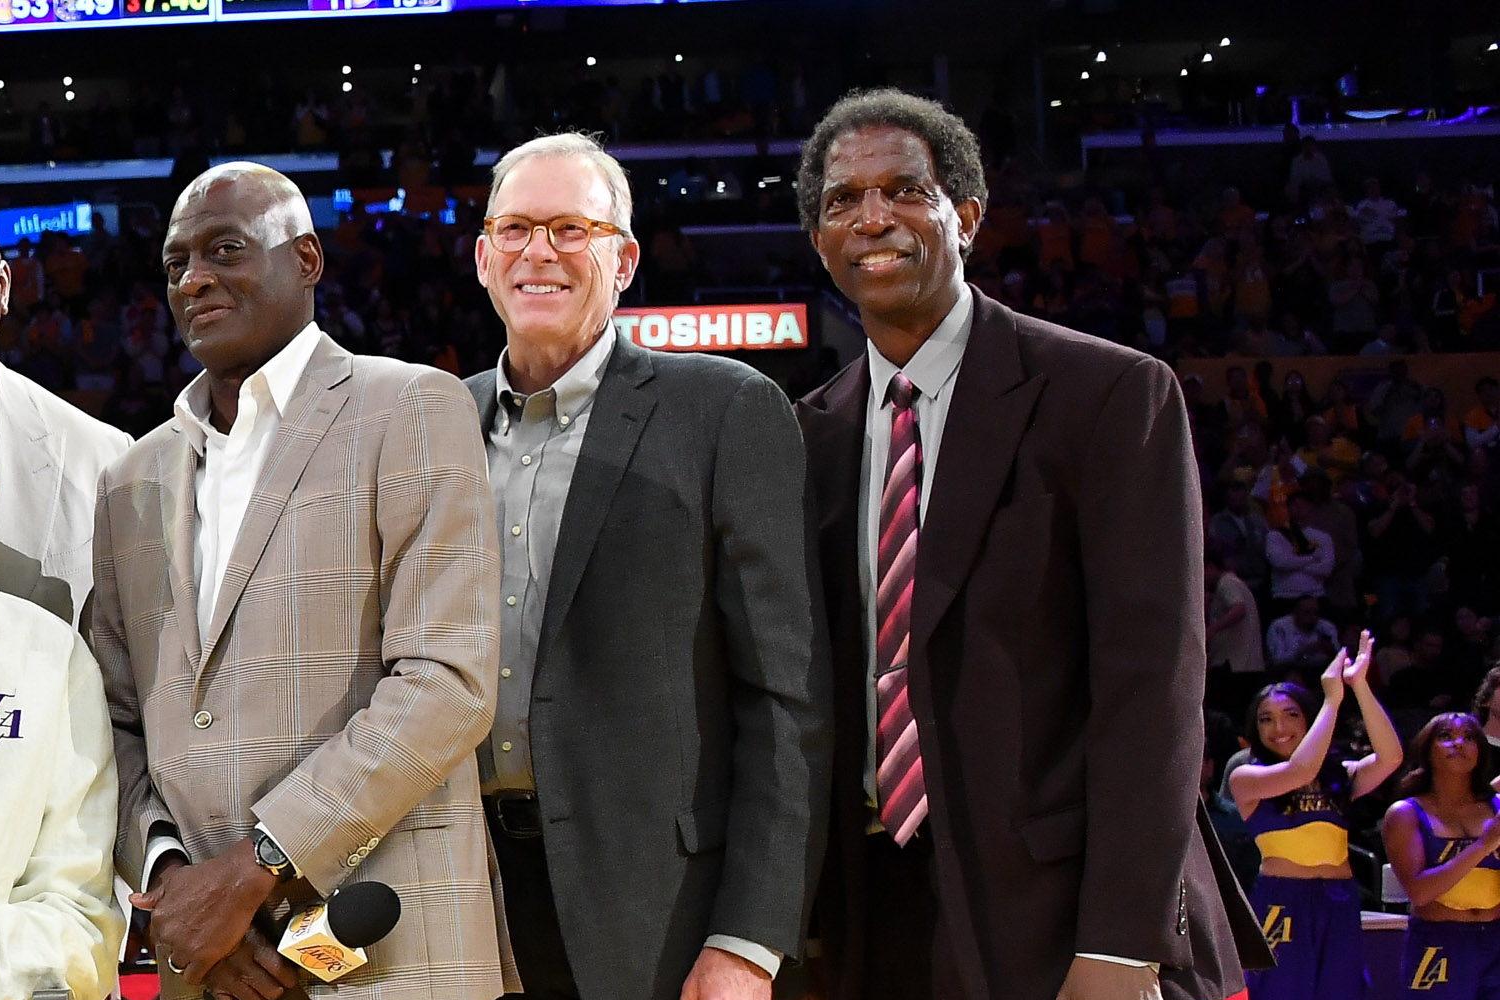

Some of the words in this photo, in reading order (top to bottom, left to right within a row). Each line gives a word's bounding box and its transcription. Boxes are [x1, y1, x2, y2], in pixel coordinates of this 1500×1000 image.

[614, 312, 804, 347] TOSHIBA
[296, 944, 352, 974] LAKERS
[1408, 946, 1449, 990] LA
